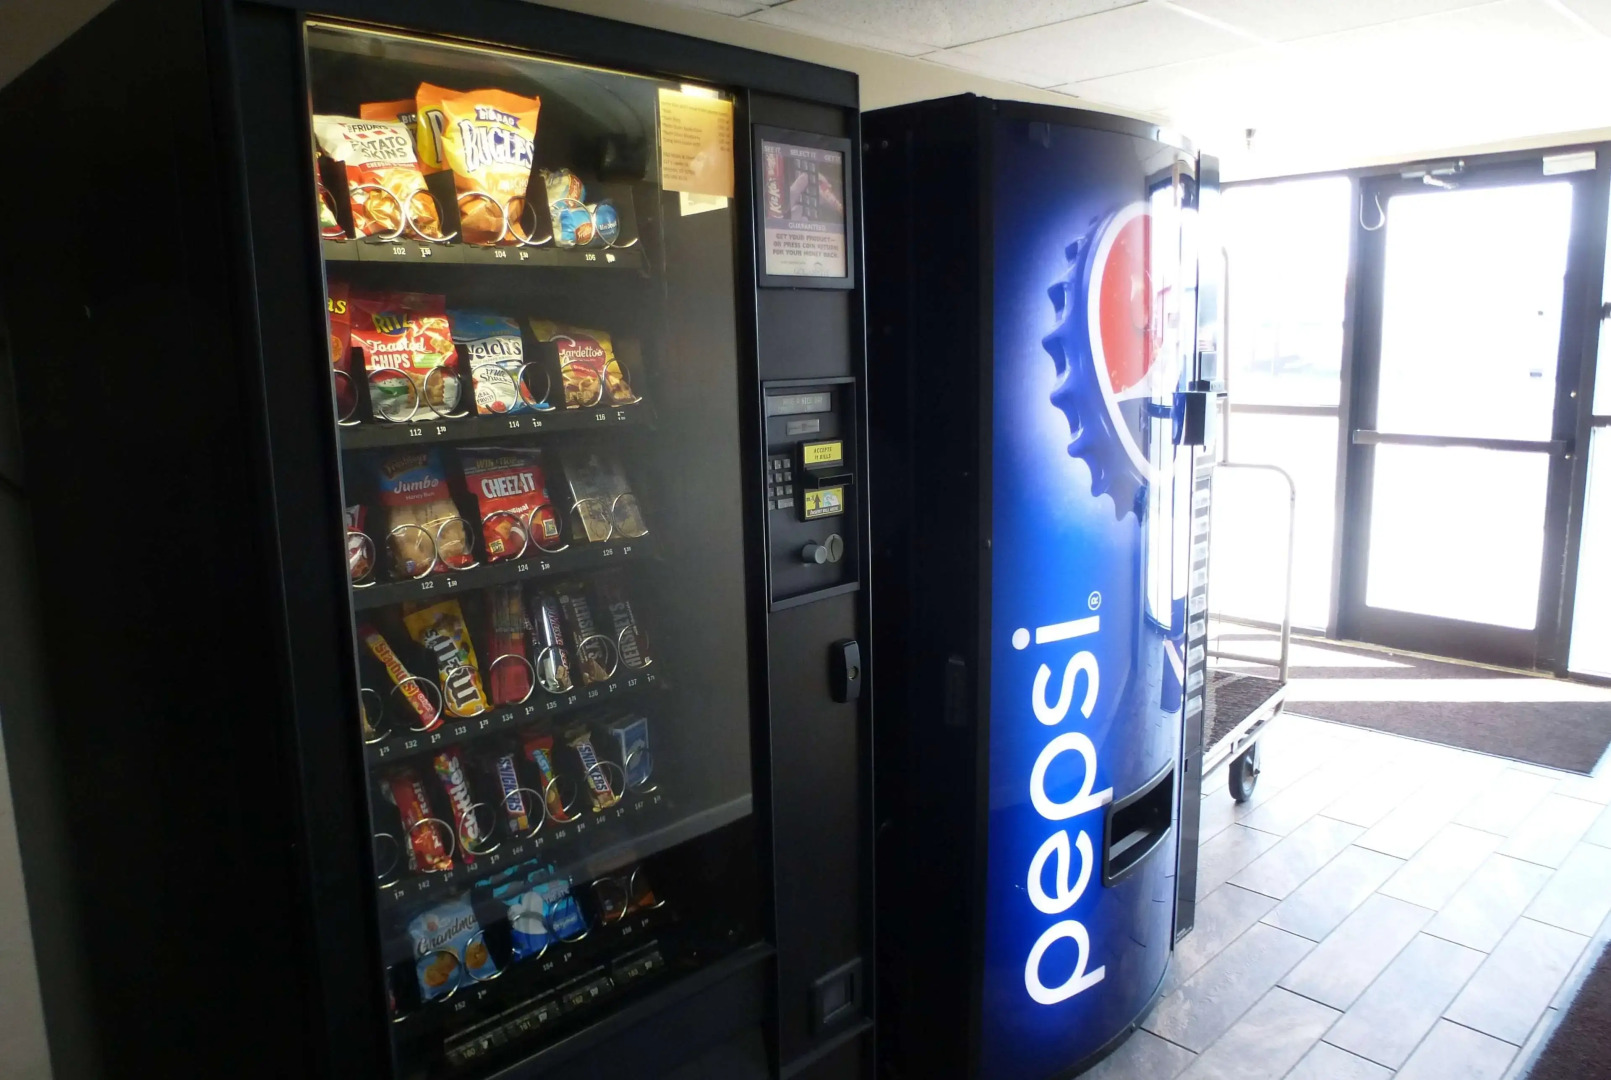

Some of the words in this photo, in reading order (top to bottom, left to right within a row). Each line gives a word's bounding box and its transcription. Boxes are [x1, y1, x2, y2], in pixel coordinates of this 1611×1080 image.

[458, 119, 534, 173] BUGLES
[361, 147, 408, 160] SKINS
[789, 233, 804, 241] YOUR
[783, 241, 800, 249] PRESS
[393, 247, 406, 255] 102
[495, 250, 506, 258] 104
[367, 337, 430, 353] Toasted
[371, 353, 411, 369] CHIPS
[596, 413, 606, 421] 116
[508, 420, 520, 428] 114
[410, 428, 422, 437] 112
[393, 475, 440, 494] Jumbo
[518, 563, 529, 572] 124
[421, 581, 434, 590] 122
[628, 678, 638, 687] 137
[588, 689, 599, 698] 136
[546, 700, 557, 710] 135
[502, 713, 514, 722] 134
[454, 726, 467, 735] 133
[405, 739, 418, 749] 132
[1012, 615, 1113, 1006] pepsi
[555, 830, 566, 840] 145
[466, 863, 478, 872] 143
[418, 881, 430, 891] 142
